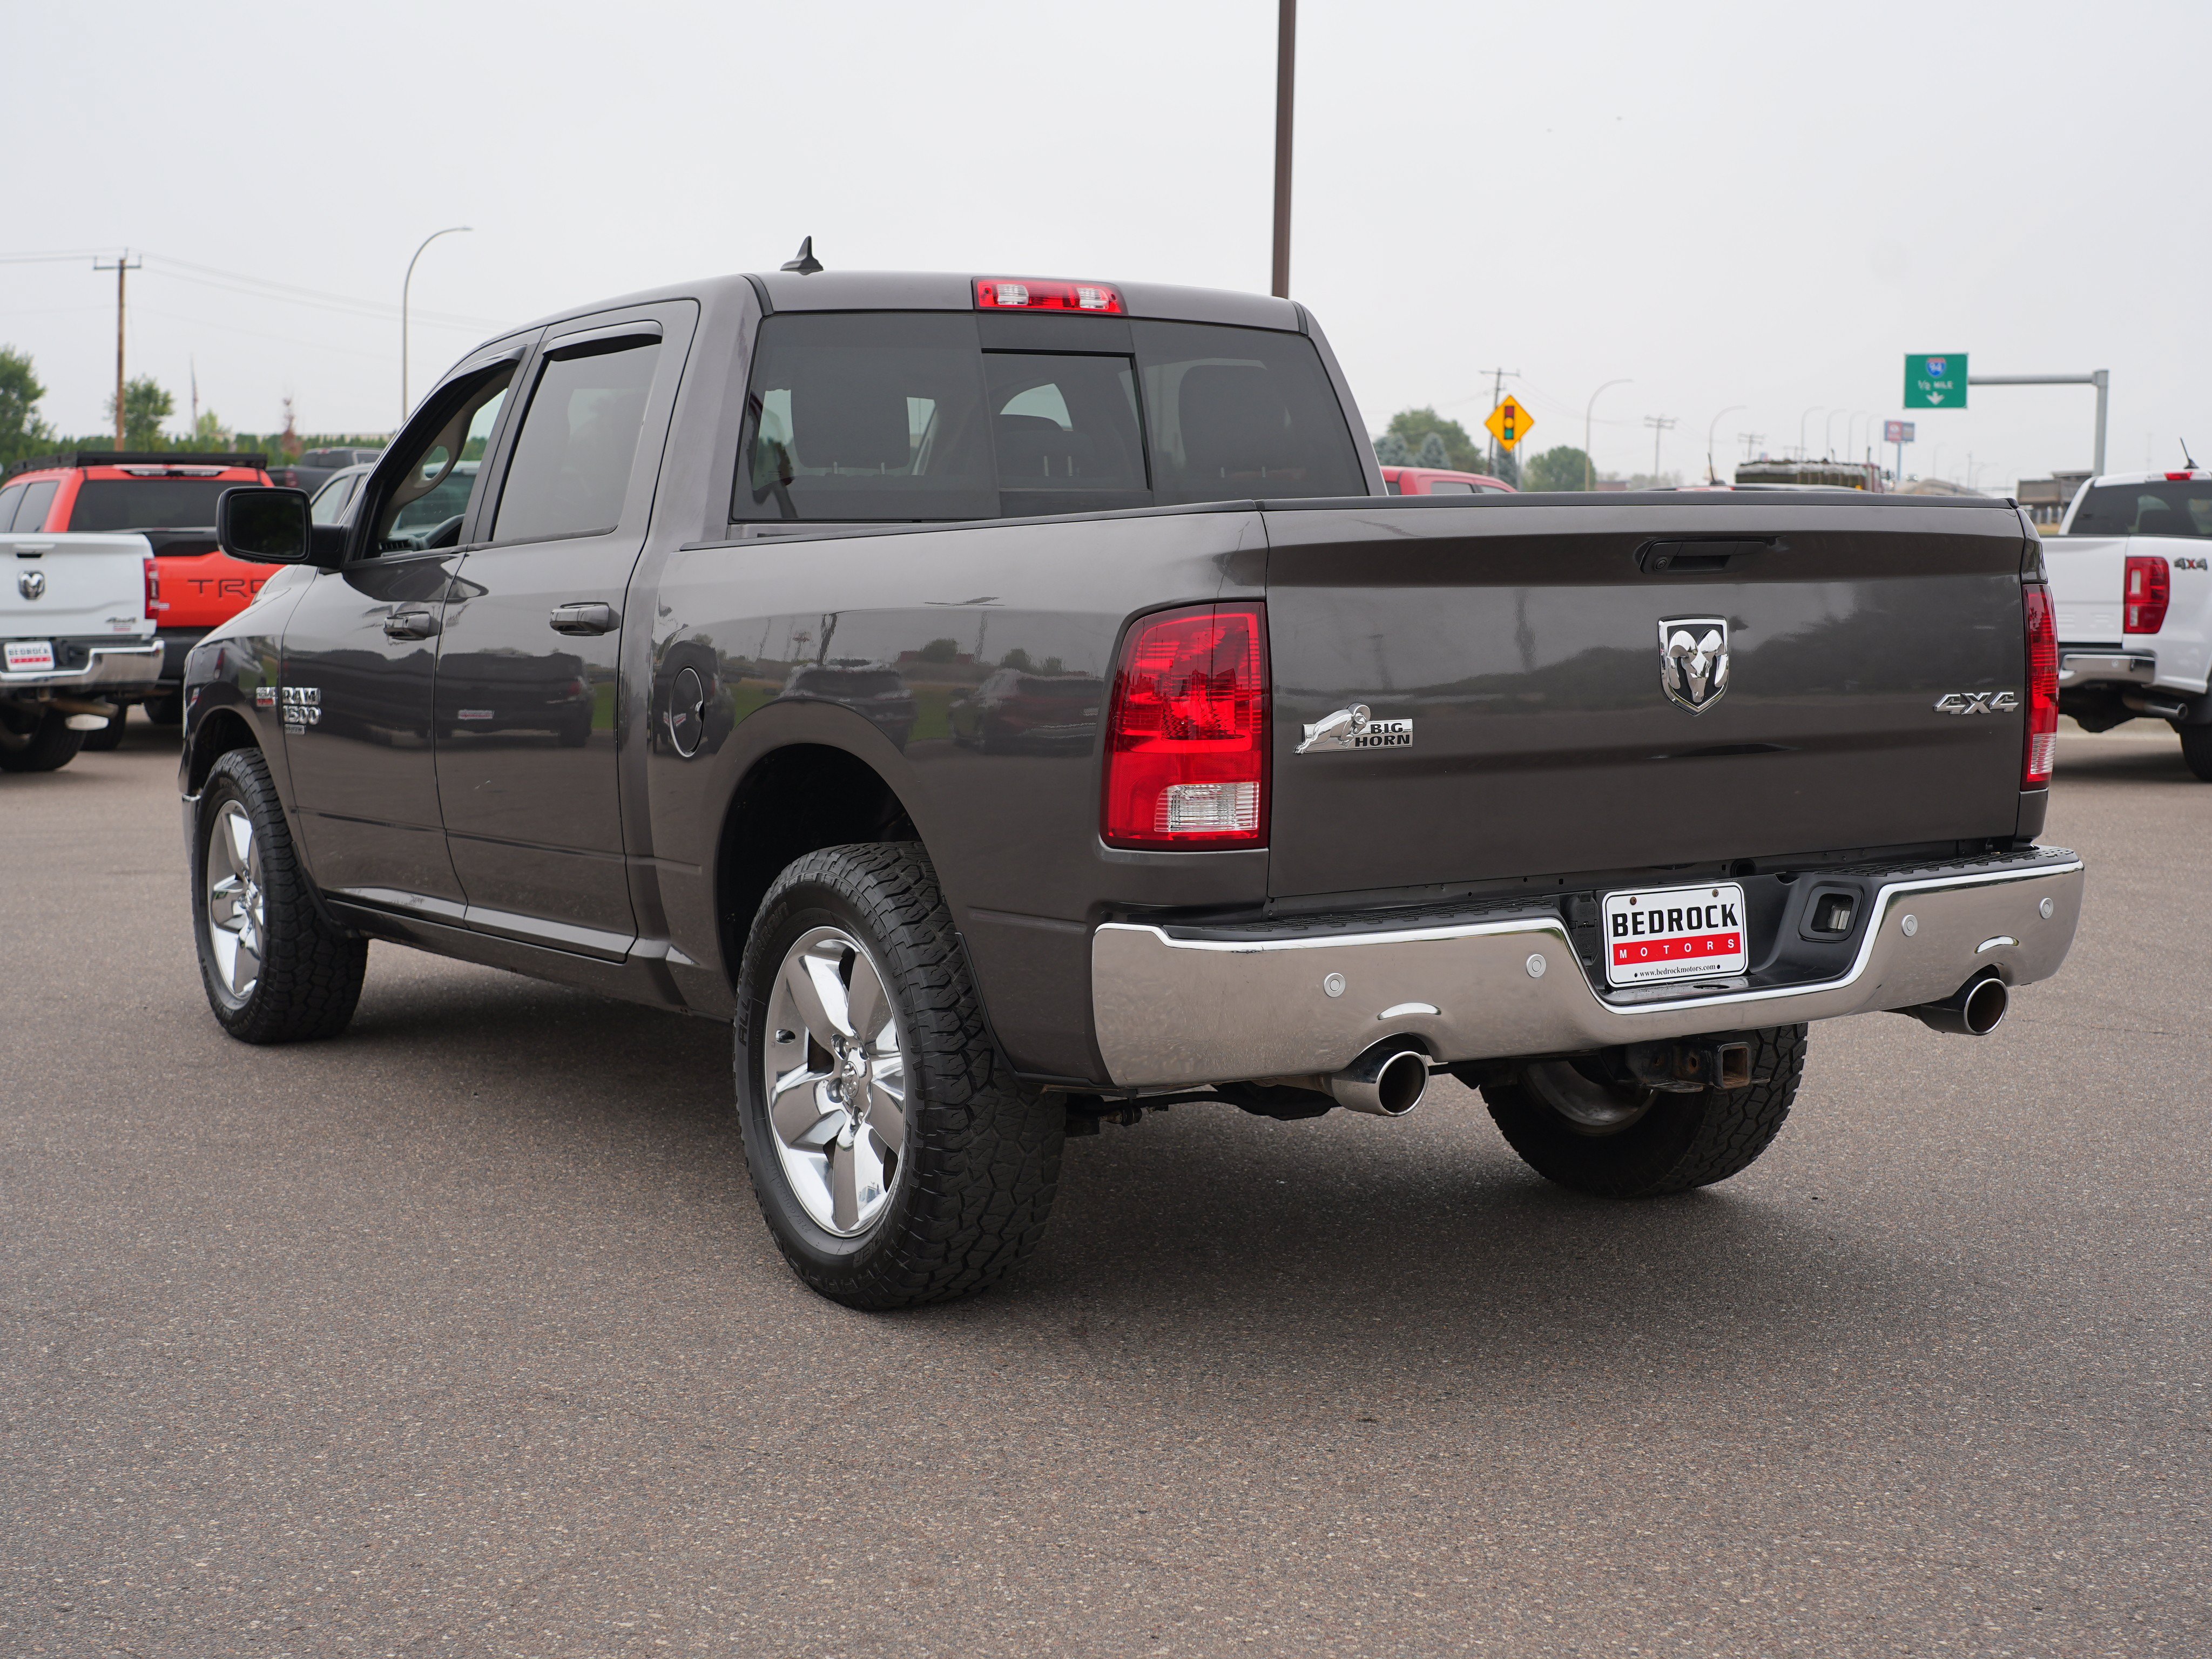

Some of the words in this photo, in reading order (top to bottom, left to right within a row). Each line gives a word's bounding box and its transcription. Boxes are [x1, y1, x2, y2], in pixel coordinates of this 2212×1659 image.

[1933, 380, 1954, 389] MILE
[282, 686, 321, 705] RAM
[282, 705, 322, 725] 1500
[1370, 723, 1404, 734] BIG
[1354, 734, 1410, 747] HORN
[1612, 903, 1738, 937] BEDROCK
[1619, 939, 1735, 959] MOTORS
[1640, 963, 1716, 977] www.bedrockmotors.com
